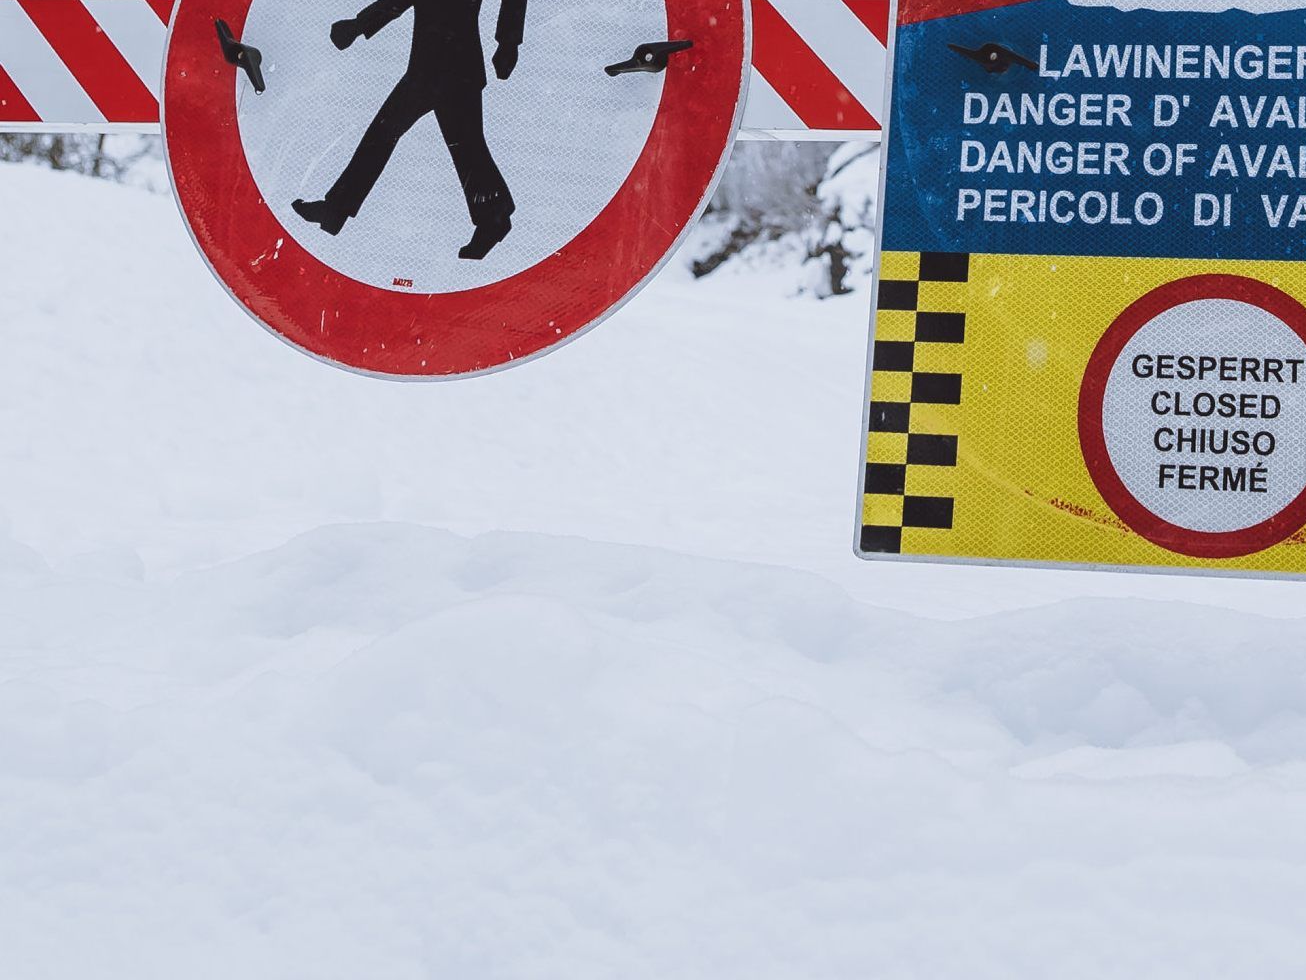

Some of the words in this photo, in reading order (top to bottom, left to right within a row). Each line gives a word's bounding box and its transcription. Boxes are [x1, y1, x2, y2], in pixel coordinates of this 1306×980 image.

[963, 92, 1132, 127] DANGER
[1153, 94, 1190, 127] D'
[960, 140, 1130, 176] DANGER
[1143, 142, 1198, 177] OF
[956, 188, 1164, 226] PERICOLO
[1193, 193, 1232, 228] DI
[1131, 353, 1305, 384] GESPERRT
[1150, 390, 1281, 419] CLOSED
[1153, 427, 1276, 457] CHIUSO
[1158, 462, 1268, 493] FERMÉ
